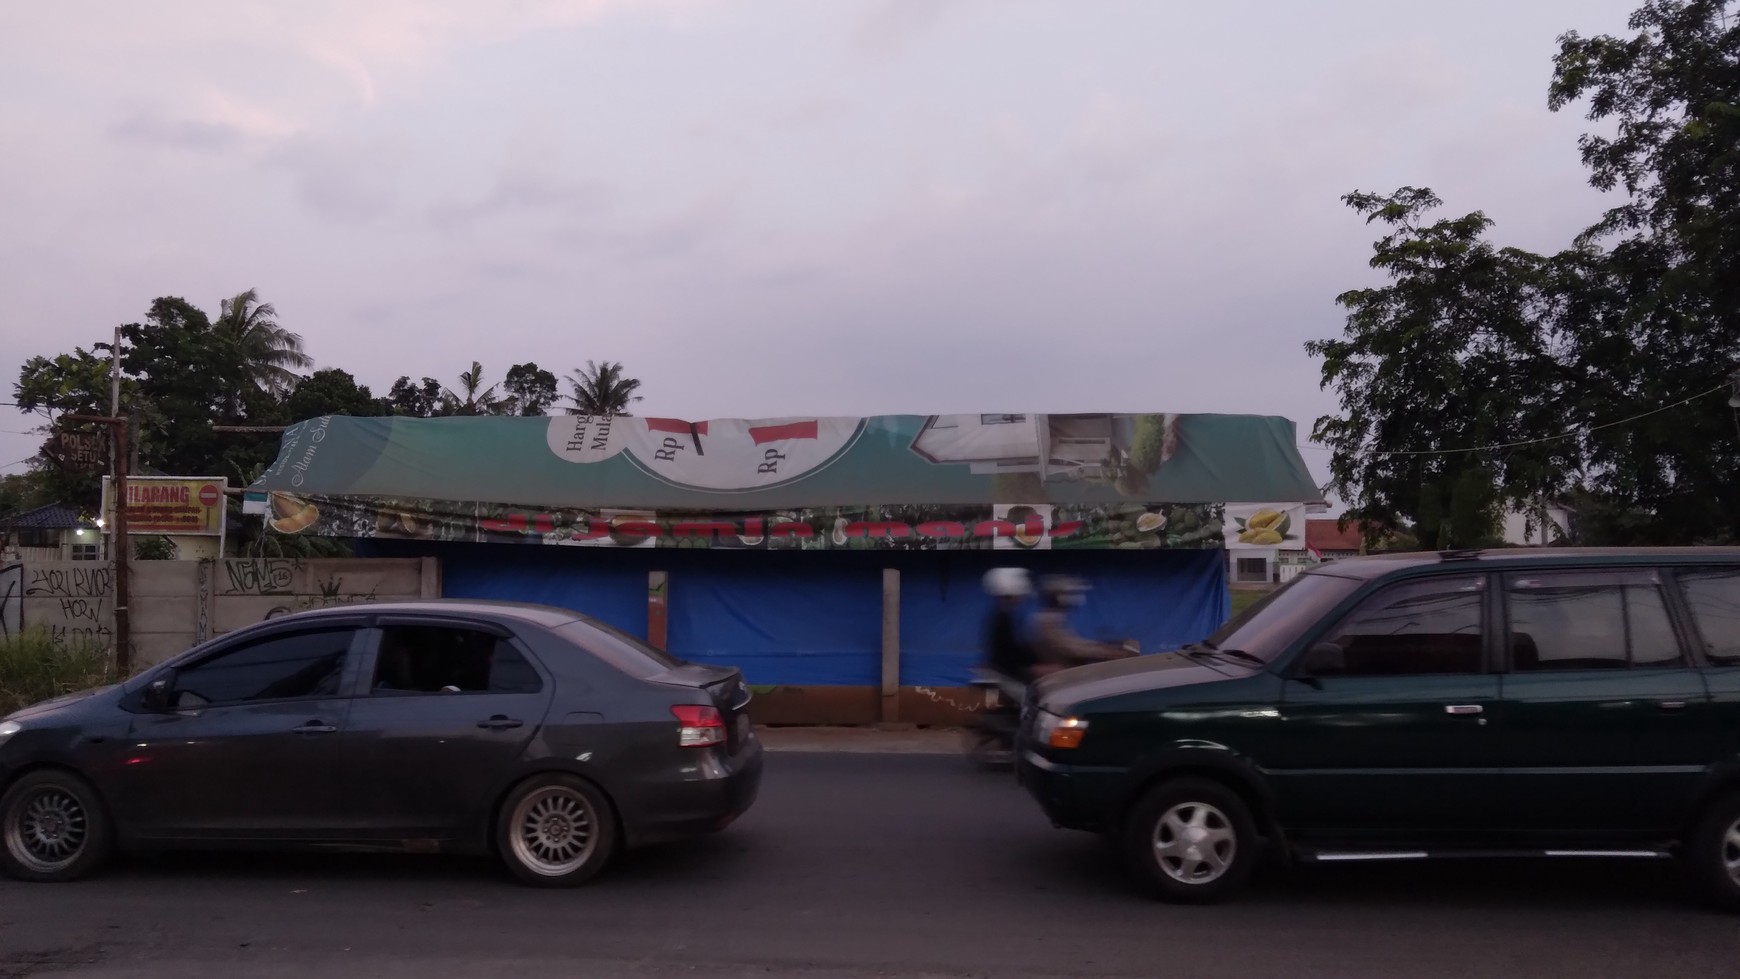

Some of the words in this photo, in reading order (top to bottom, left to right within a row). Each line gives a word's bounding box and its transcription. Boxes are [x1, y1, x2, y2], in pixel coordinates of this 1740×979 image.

[71, 450, 96, 462] SETU
[654, 437, 685, 462] Rp
[758, 448, 786, 475] Rp
[291, 445, 318, 487] Alam
[127, 485, 190, 503] ILARANG
